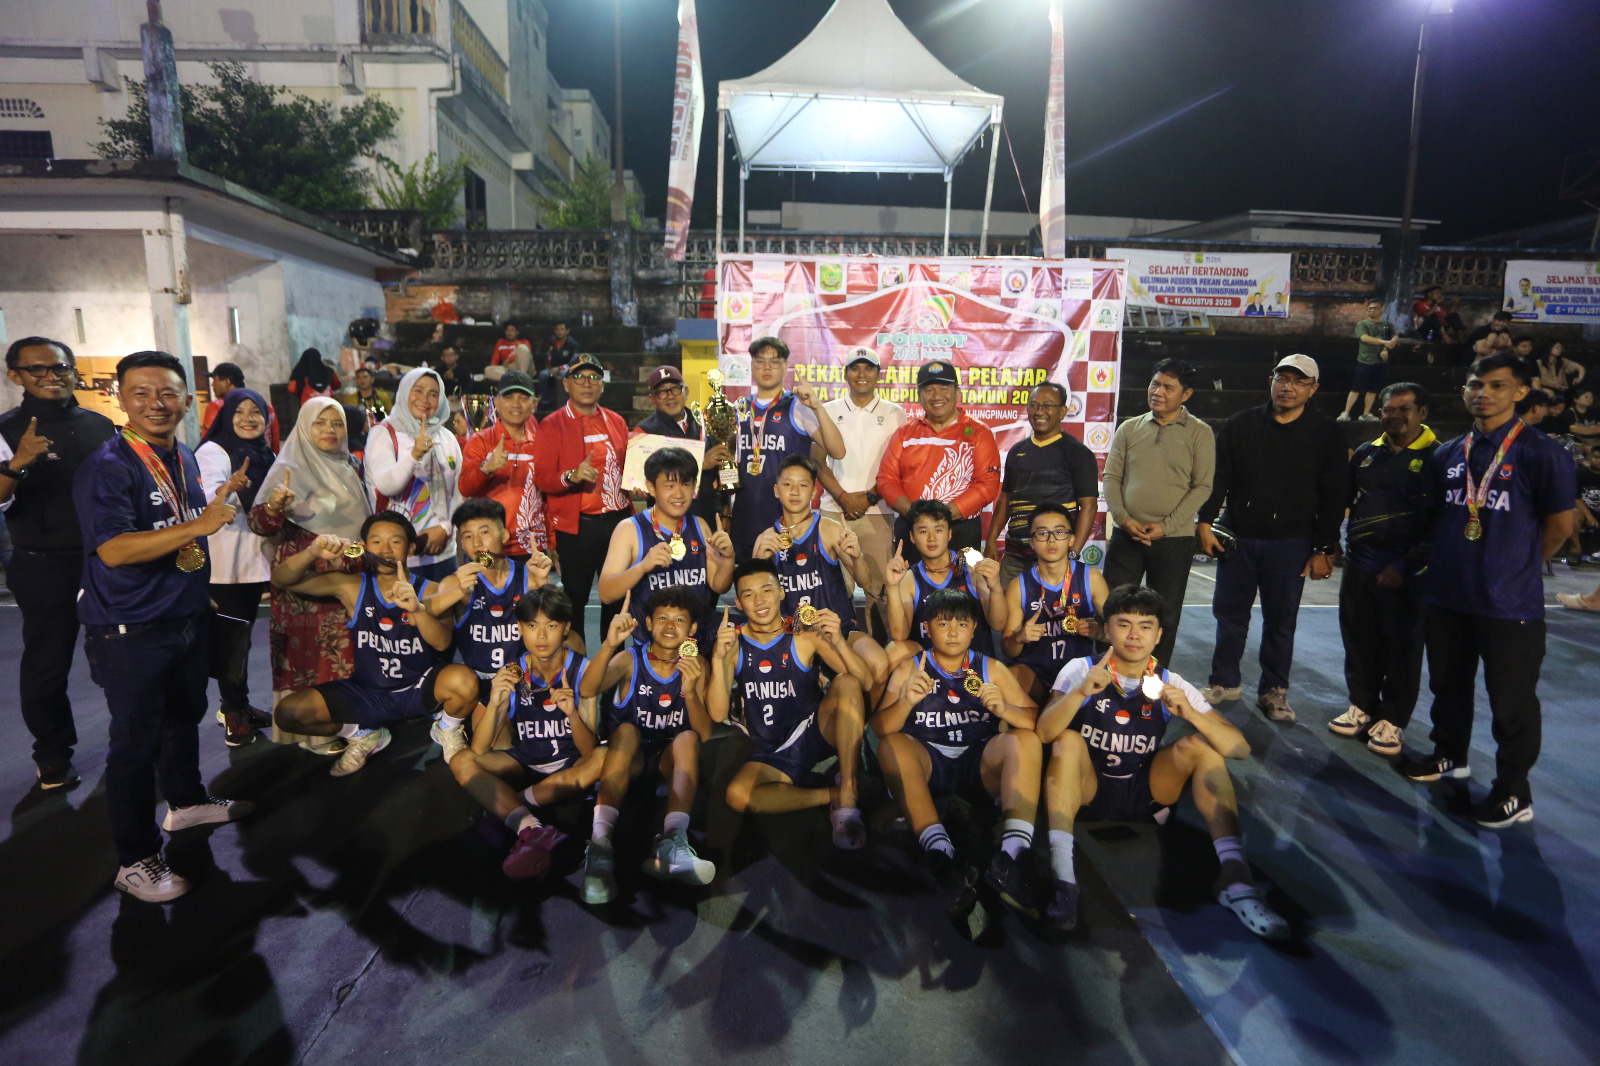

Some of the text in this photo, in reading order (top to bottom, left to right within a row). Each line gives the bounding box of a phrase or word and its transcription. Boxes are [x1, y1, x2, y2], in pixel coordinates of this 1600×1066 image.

[1148, 265, 1249, 277] SELAMAT BERTANDING
[1170, 277, 1197, 286] PESERTA
[1199, 278, 1221, 287] PEKAN
[1222, 278, 1257, 288] OLAHRAGA
[1546, 275, 1585, 285] SELAMAT
[1147, 285, 1249, 296] PELAJAR KOTA TANJUNGPINANG
[1182, 297, 1214, 306] AGUSTUS
[877, 333, 967, 348] POPKOT
[893, 347, 919, 360] 2025
[659, 368, 671, 379] L
[961, 389, 1008, 404] TAHUN
[1051, 639, 1067, 661] 17
[490, 647, 505, 669] 9
[762, 704, 774, 726] 2
[516, 716, 573, 741] PELNUS
[947, 729, 963, 742] 11
[1080, 723, 1156, 755] PELNUSA
